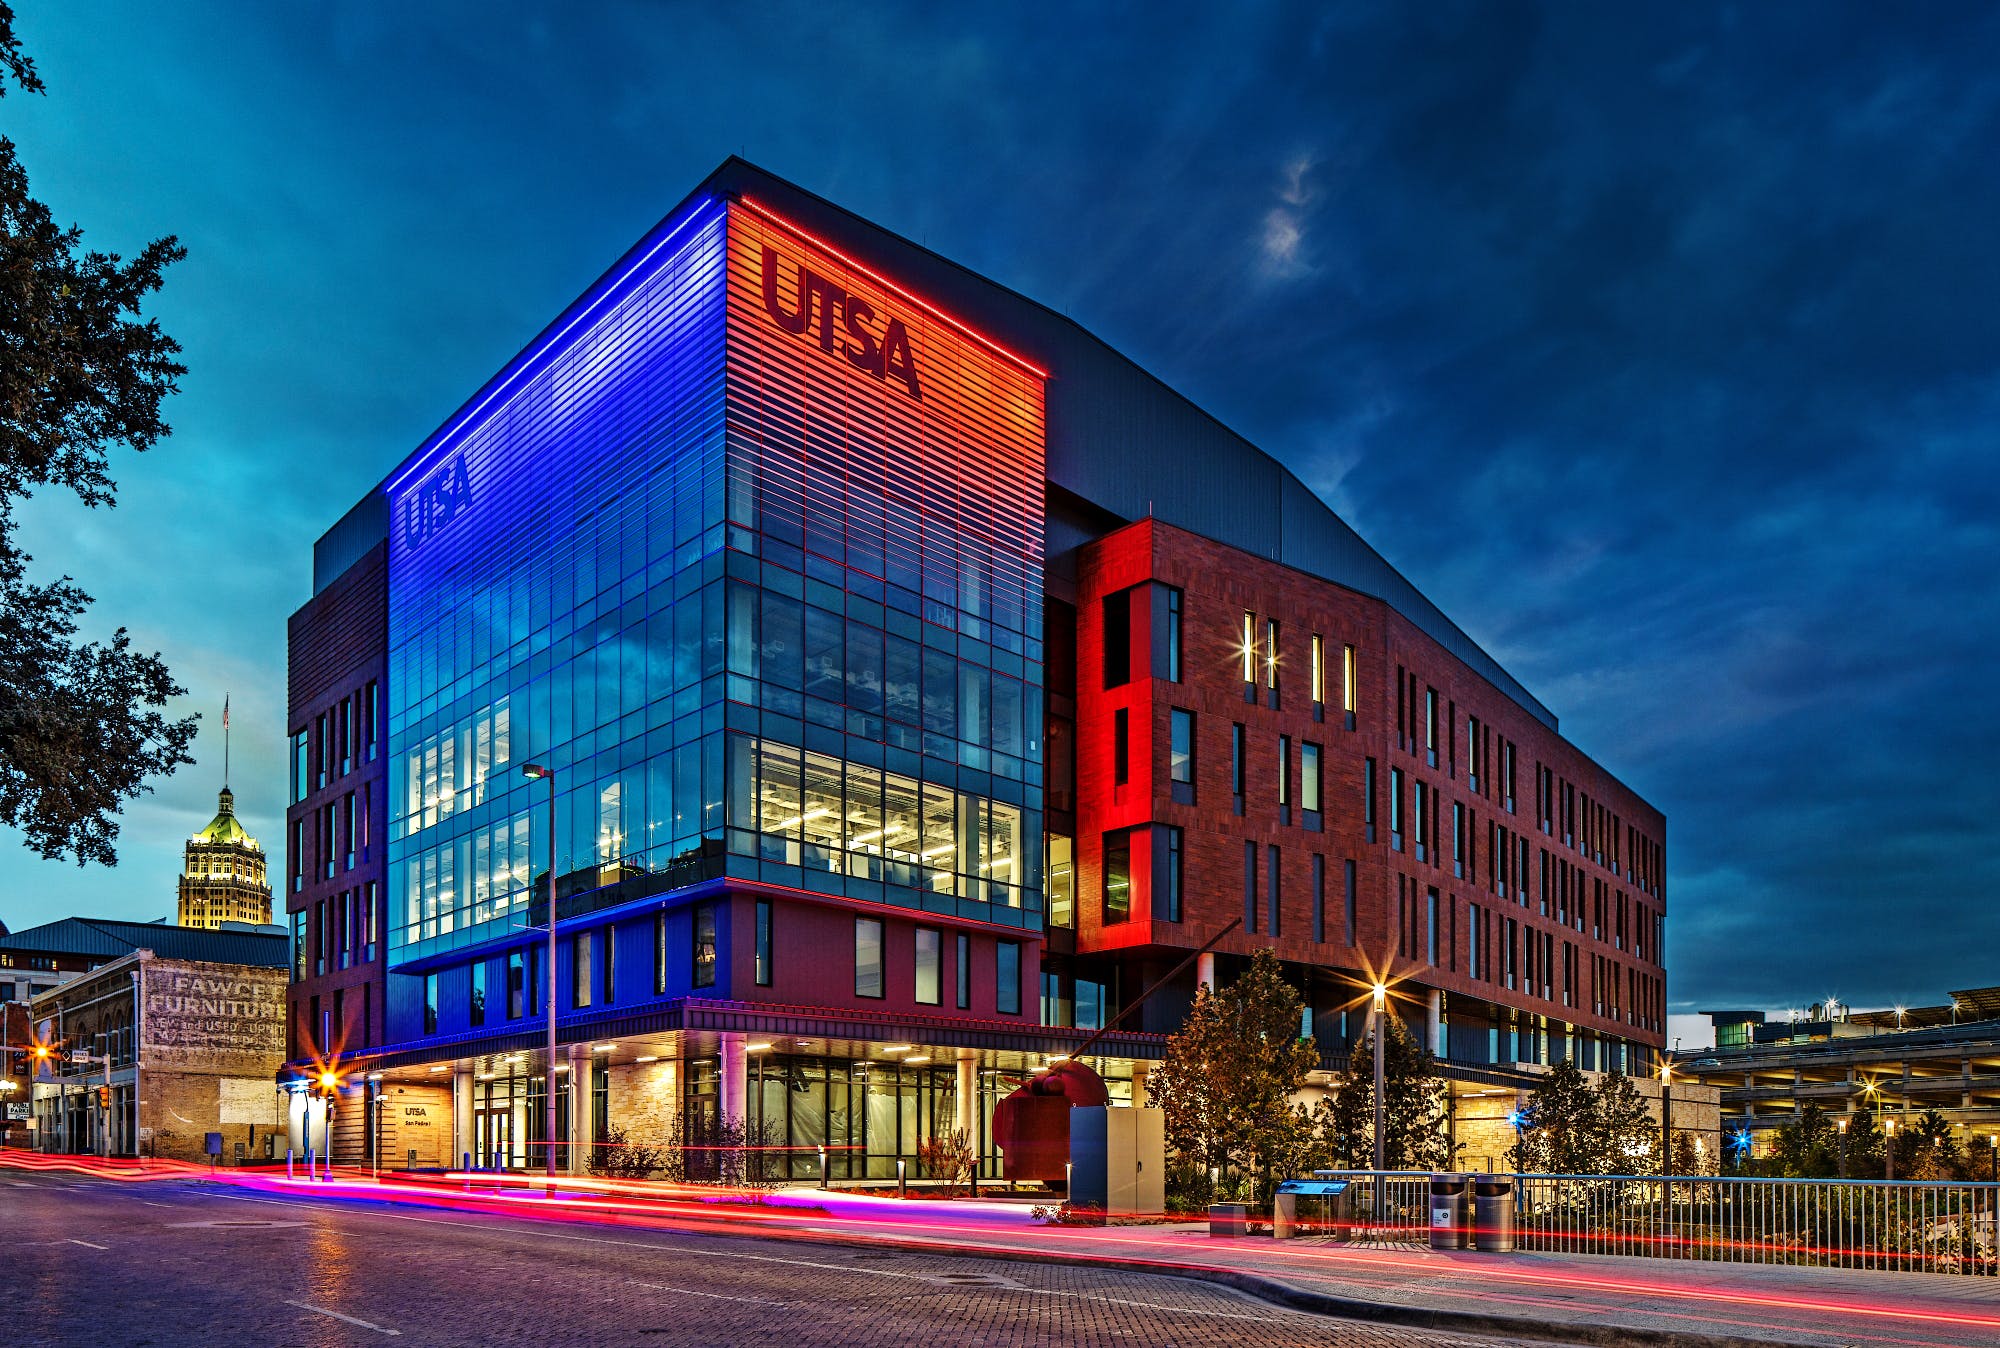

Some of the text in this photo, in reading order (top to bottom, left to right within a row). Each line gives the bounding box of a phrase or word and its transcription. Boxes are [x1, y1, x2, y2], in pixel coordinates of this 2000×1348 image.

[762, 244, 923, 401] UTSA
[405, 452, 473, 550] UTSA
[150, 994, 287, 1020] FURNITURE
[405, 1107, 426, 1116] UTSA
